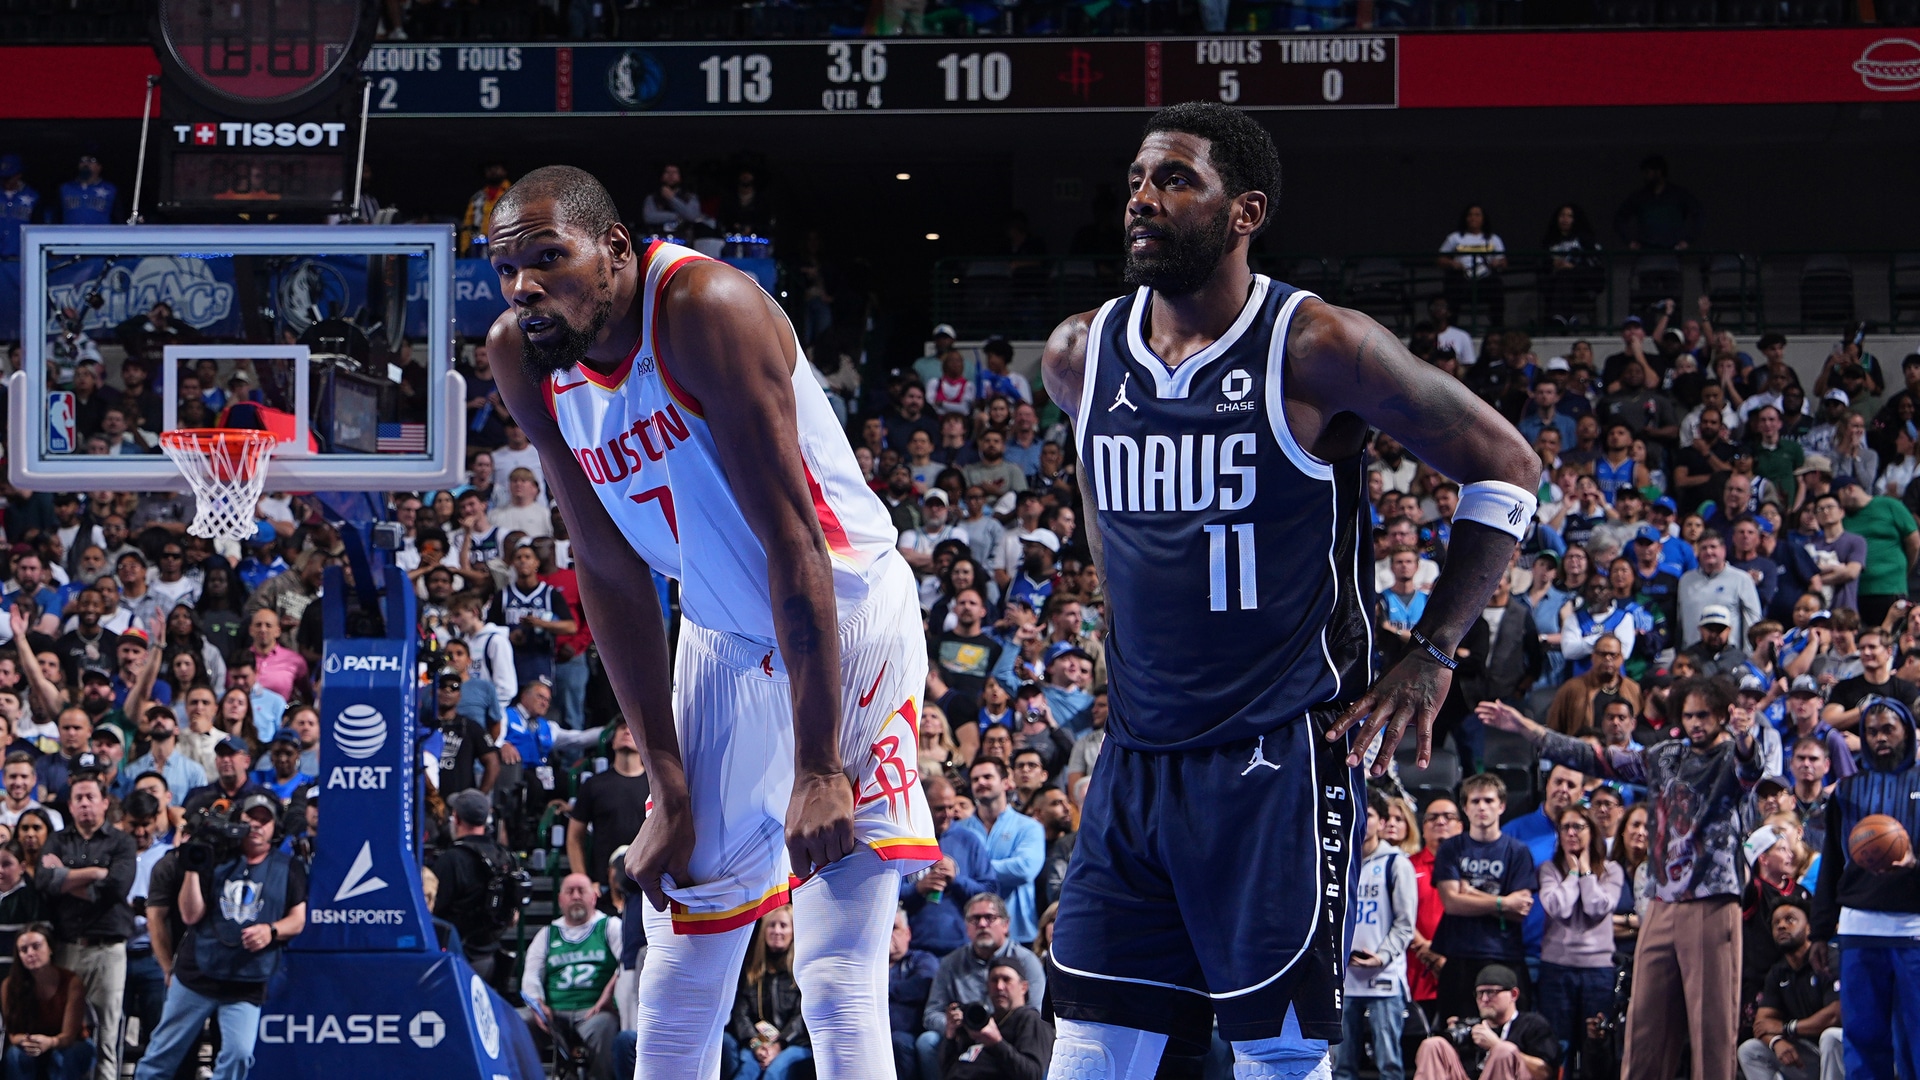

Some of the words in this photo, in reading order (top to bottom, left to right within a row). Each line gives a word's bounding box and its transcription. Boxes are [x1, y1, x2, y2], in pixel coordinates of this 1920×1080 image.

[361, 48, 441, 71] MEOUTS
[457, 48, 522, 71] FOULS
[827, 42, 887, 82] 3.6
[1196, 41, 1261, 64] FOULS
[1280, 39, 1386, 63] TIMEOUTS
[700, 55, 772, 103] 113
[938, 52, 1012, 101] 110
[1219, 71, 1240, 103] 5
[1322, 69, 1343, 102] 0
[378, 77, 398, 109] 2
[480, 77, 500, 109] 5
[822, 89, 858, 110] QTR
[867, 86, 882, 109] 4
[220, 122, 346, 147] TISSOT
[1216, 401, 1255, 412] CHASE
[629, 485, 680, 545] 7
[1203, 523, 1258, 612] 11
[327, 766, 392, 790] AT&T
[557, 964, 596, 989] 32
[259, 1014, 401, 1044] CHASE
